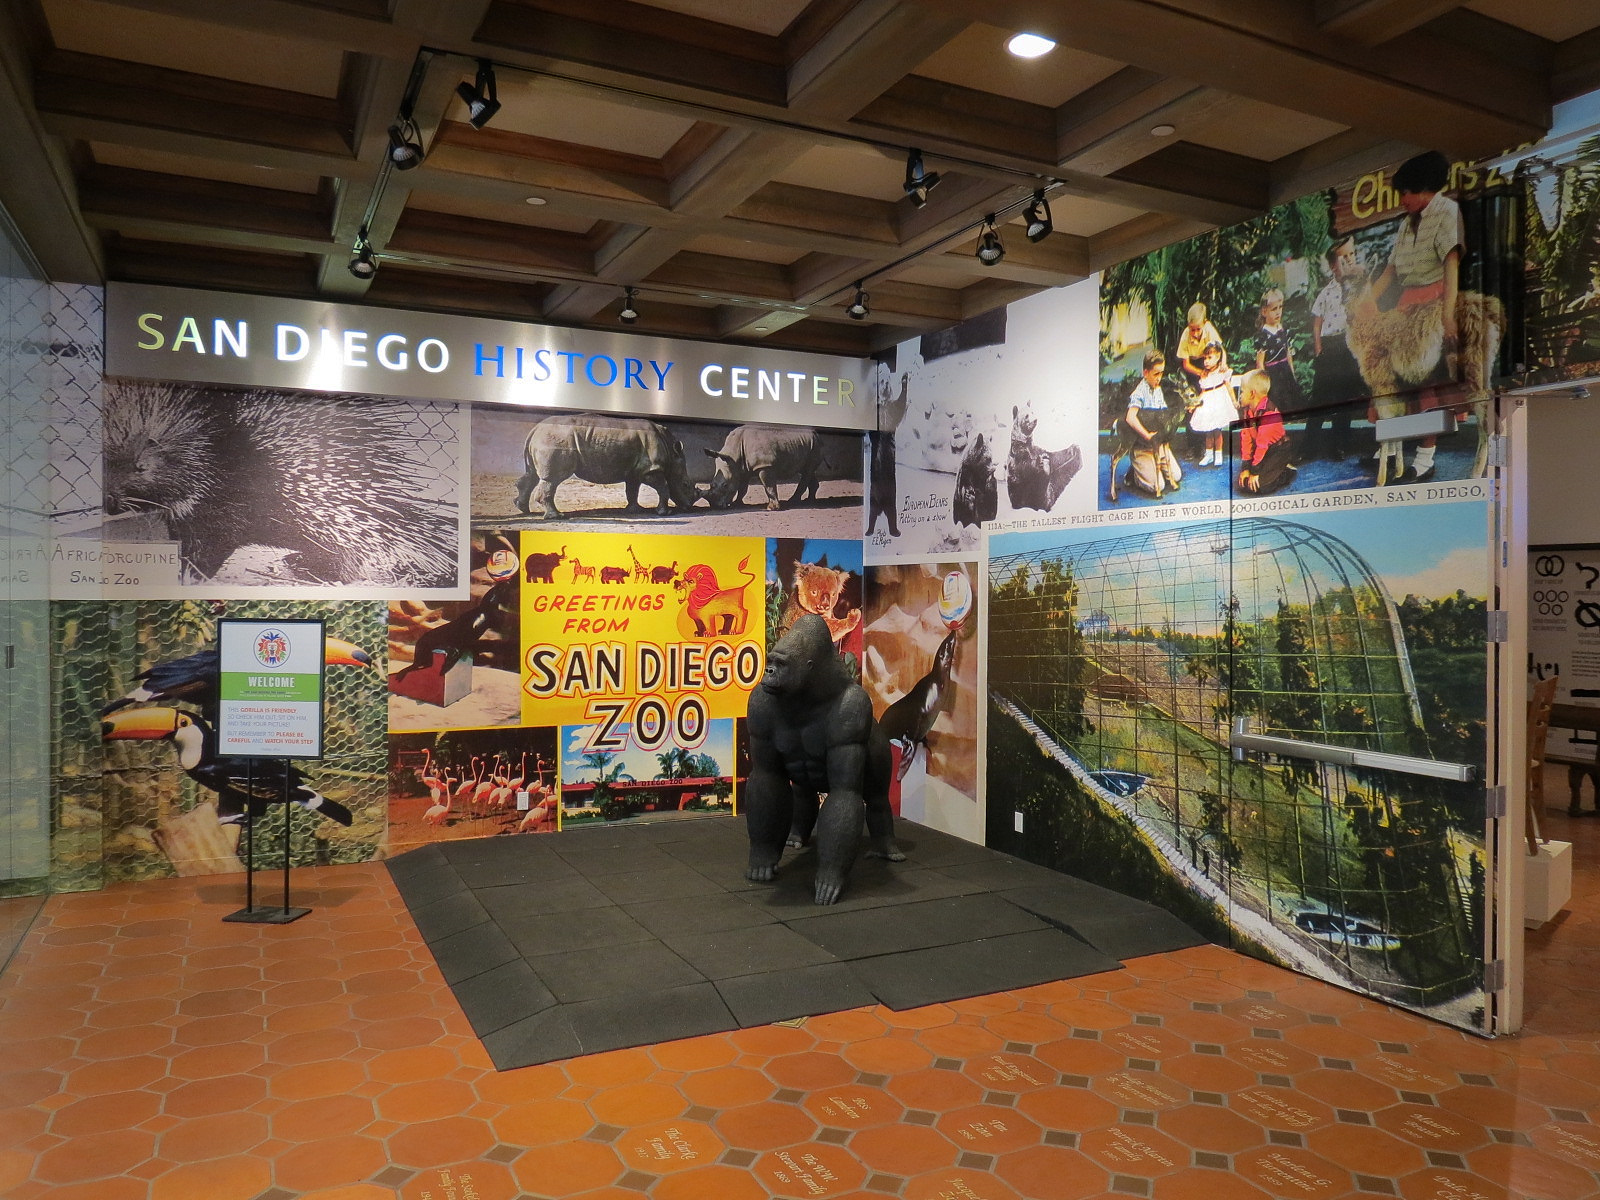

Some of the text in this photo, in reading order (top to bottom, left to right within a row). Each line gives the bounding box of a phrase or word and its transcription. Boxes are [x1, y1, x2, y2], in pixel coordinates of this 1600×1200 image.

[137, 313, 856, 408] SAN DIEGO HISTORY CENTER
[1031, 517, 1066, 527] TALLEST
[1071, 514, 1104, 525] FLIGHT
[1108, 511, 1134, 522] CAGE
[1138, 510, 1149, 519] IN
[1154, 506, 1176, 518] THE
[1230, 498, 1308, 514] ZOOLOGICAL
[1312, 493, 1378, 508] GARDEN,
[1386, 490, 1417, 503] SAN
[1426, 485, 1485, 500] DIEGO,
[533, 594, 665, 613] GREETINGS
[563, 617, 630, 634] FROM
[526, 643, 625, 696] SAN
[637, 642, 762, 691] DIEGO
[248, 676, 295, 688] WELCOME
[584, 694, 709, 752] ZOO
[664, 1127, 682, 1140] The
[645, 1137, 675, 1160] Family
[800, 1153, 818, 1165] The
[795, 1173, 828, 1195] Family
